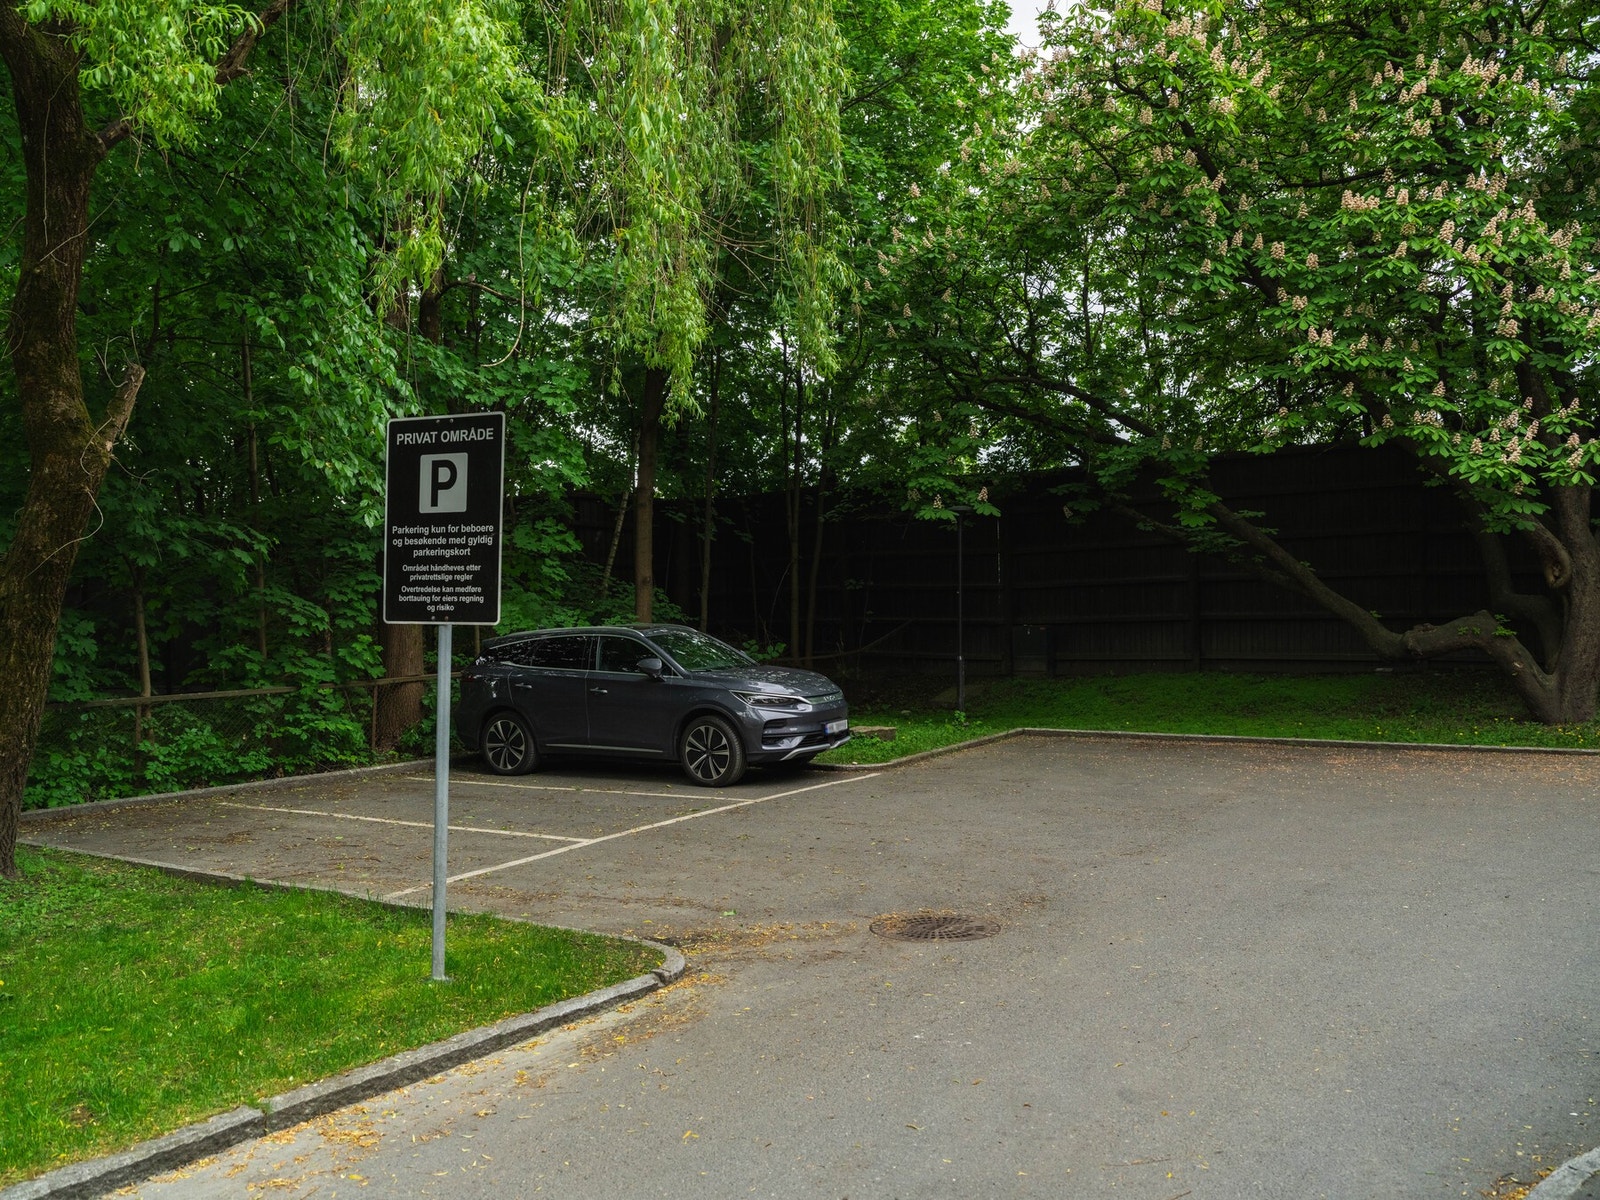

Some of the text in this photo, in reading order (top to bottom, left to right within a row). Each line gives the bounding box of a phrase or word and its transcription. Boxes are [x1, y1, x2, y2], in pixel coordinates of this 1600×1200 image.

[396, 427, 494, 445] PRIVAT OMRÅDE
[430, 459, 457, 507] P
[392, 523, 494, 535] Parkering kun for beboere
[392, 538, 403, 547] og
[448, 535, 466, 544] med
[467, 535, 493, 546] gyldig
[413, 547, 471, 558] parkeringskort
[402, 564, 429, 572] Området
[430, 563, 465, 572] håndheves
[409, 573, 473, 582] privatrettslige regler
[401, 585, 482, 593] Overtredelse kan medføre
[398, 594, 484, 603] borttauing for eiers regning
[436, 604, 455, 612] risiko
